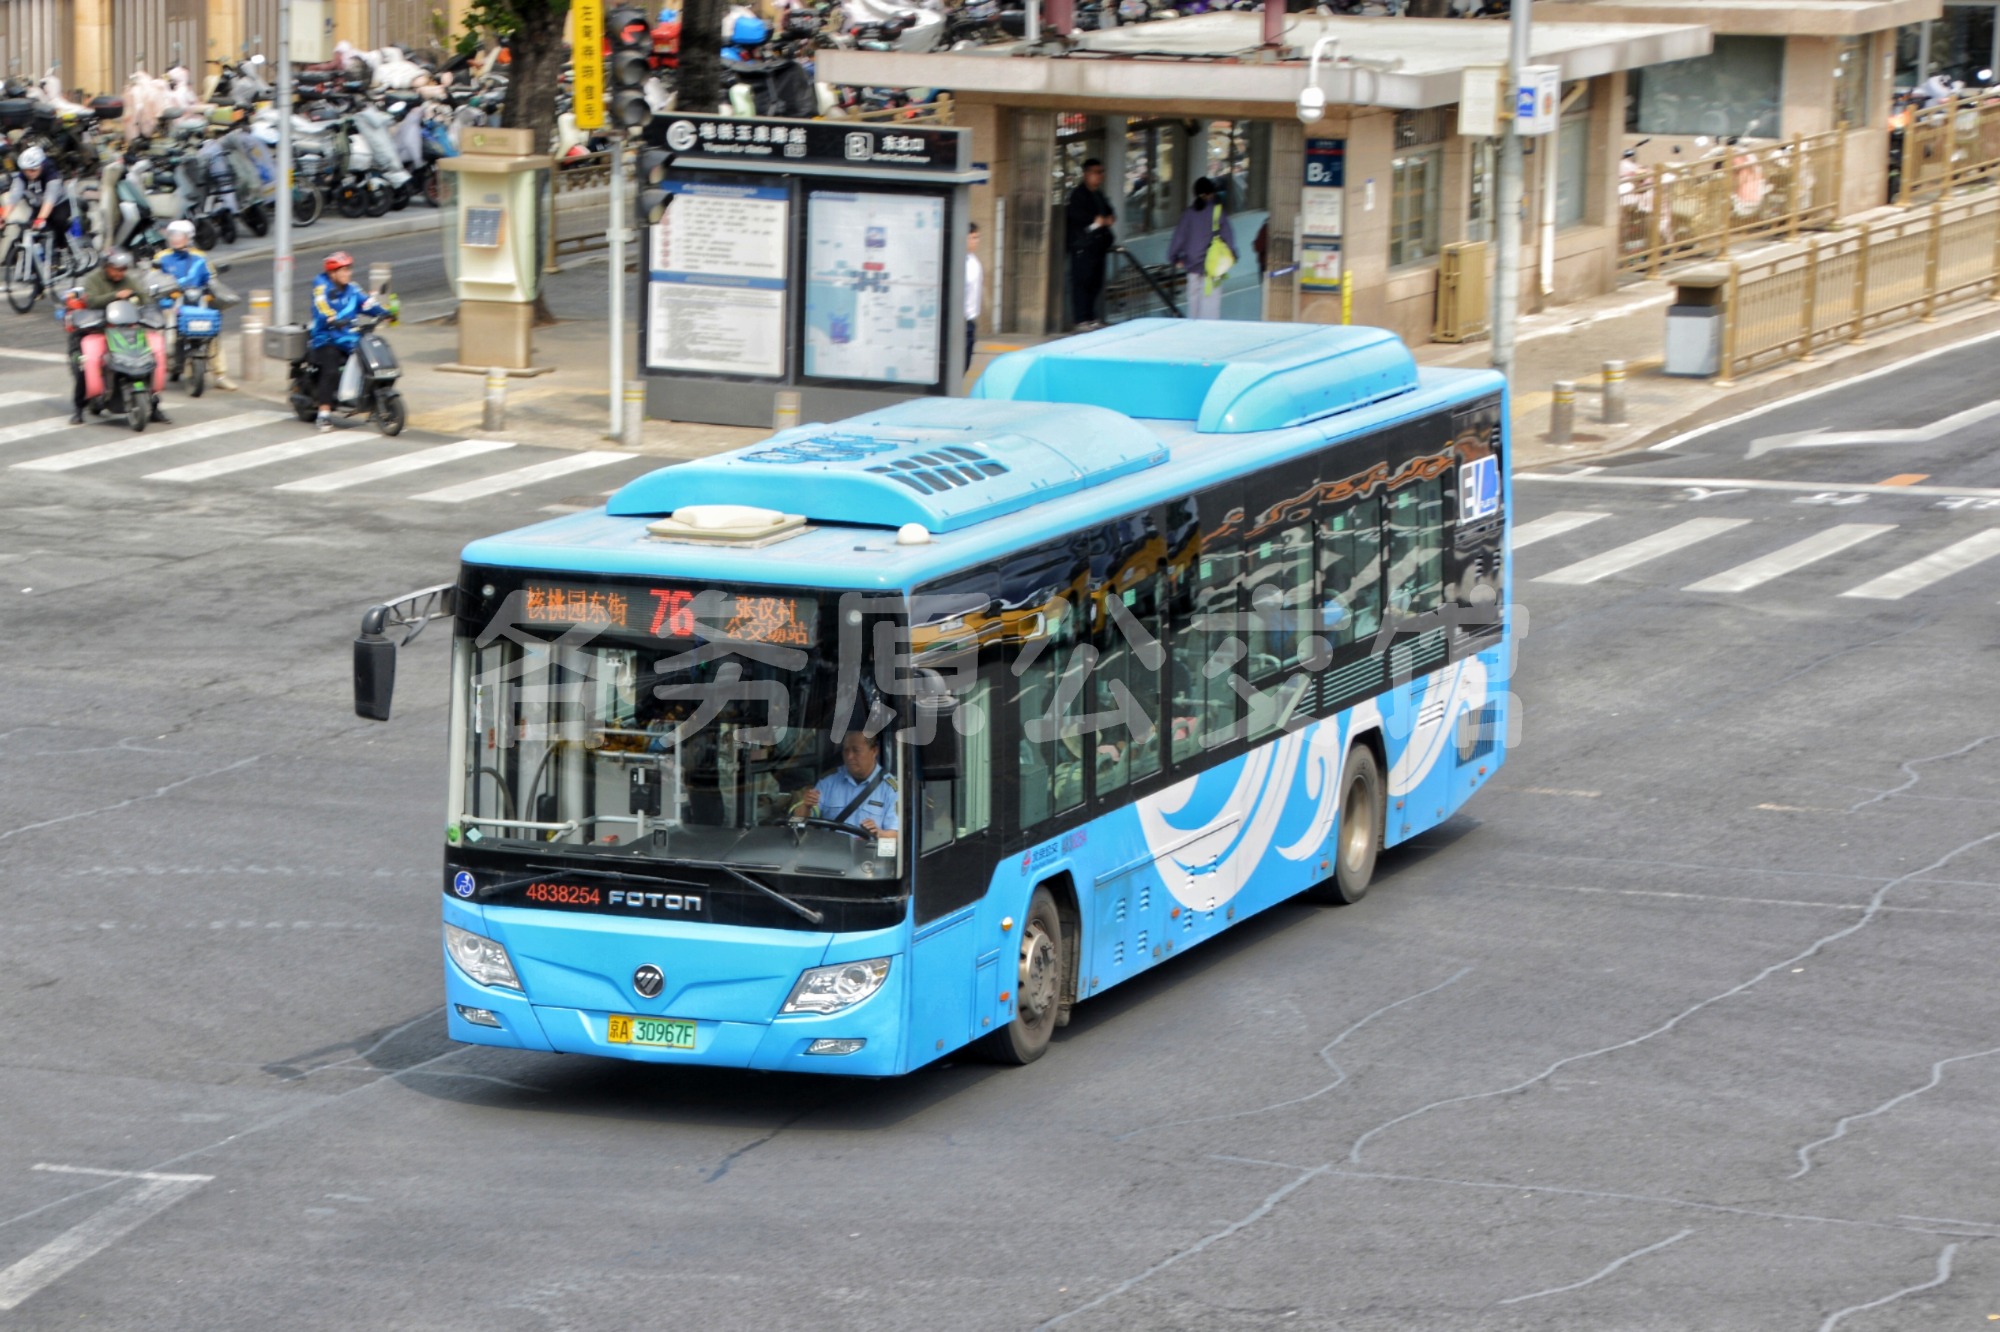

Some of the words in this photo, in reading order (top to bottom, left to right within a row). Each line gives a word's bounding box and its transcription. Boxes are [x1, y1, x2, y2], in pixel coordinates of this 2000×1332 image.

[1307, 162, 1332, 183] B2
[526, 585, 629, 627] 核桃园东街
[650, 589, 695, 637] 76
[734, 595, 798, 626] 张仪村
[725, 616, 809, 646] 公交场站
[525, 883, 600, 905] 4838254
[608, 890, 702, 911] FOTON
[609, 1020, 629, 1040] 京A
[636, 1021, 694, 1044] 30967F
